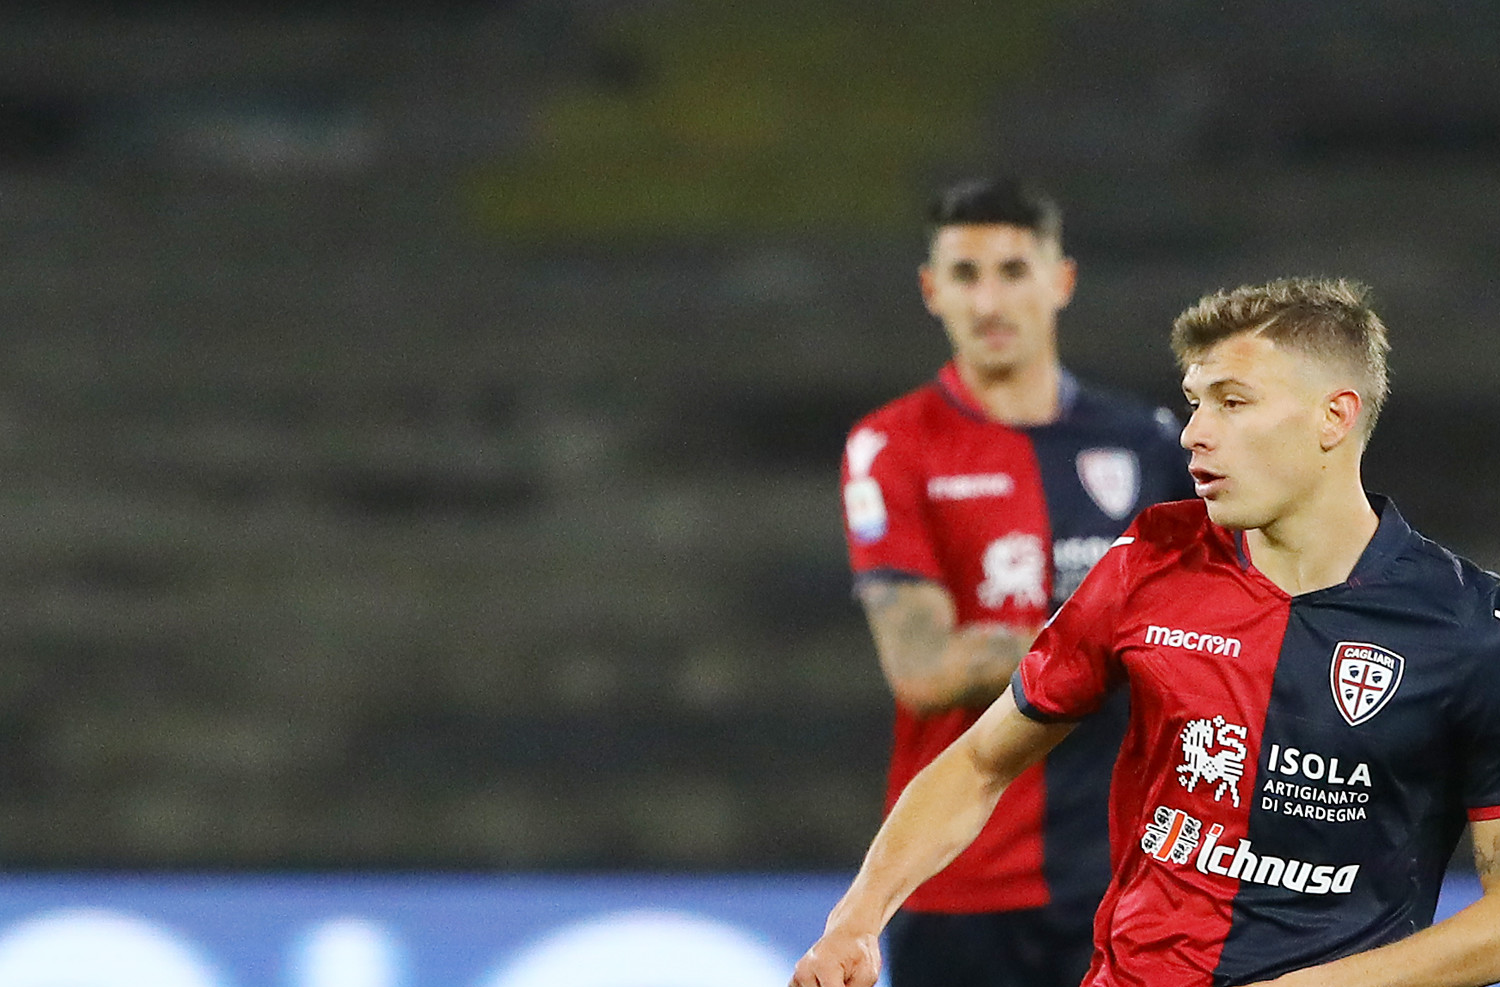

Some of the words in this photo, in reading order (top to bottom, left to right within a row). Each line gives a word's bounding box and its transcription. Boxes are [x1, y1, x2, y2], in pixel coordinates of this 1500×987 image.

[1145, 625, 1241, 658] macron
[1344, 647, 1395, 670] CAGLIARI
[1268, 744, 1372, 787] ISOLA
[1263, 779, 1369, 804] ARTIGIANATO
[1262, 796, 1278, 812] DI
[1284, 801, 1367, 822] SARDEGNA
